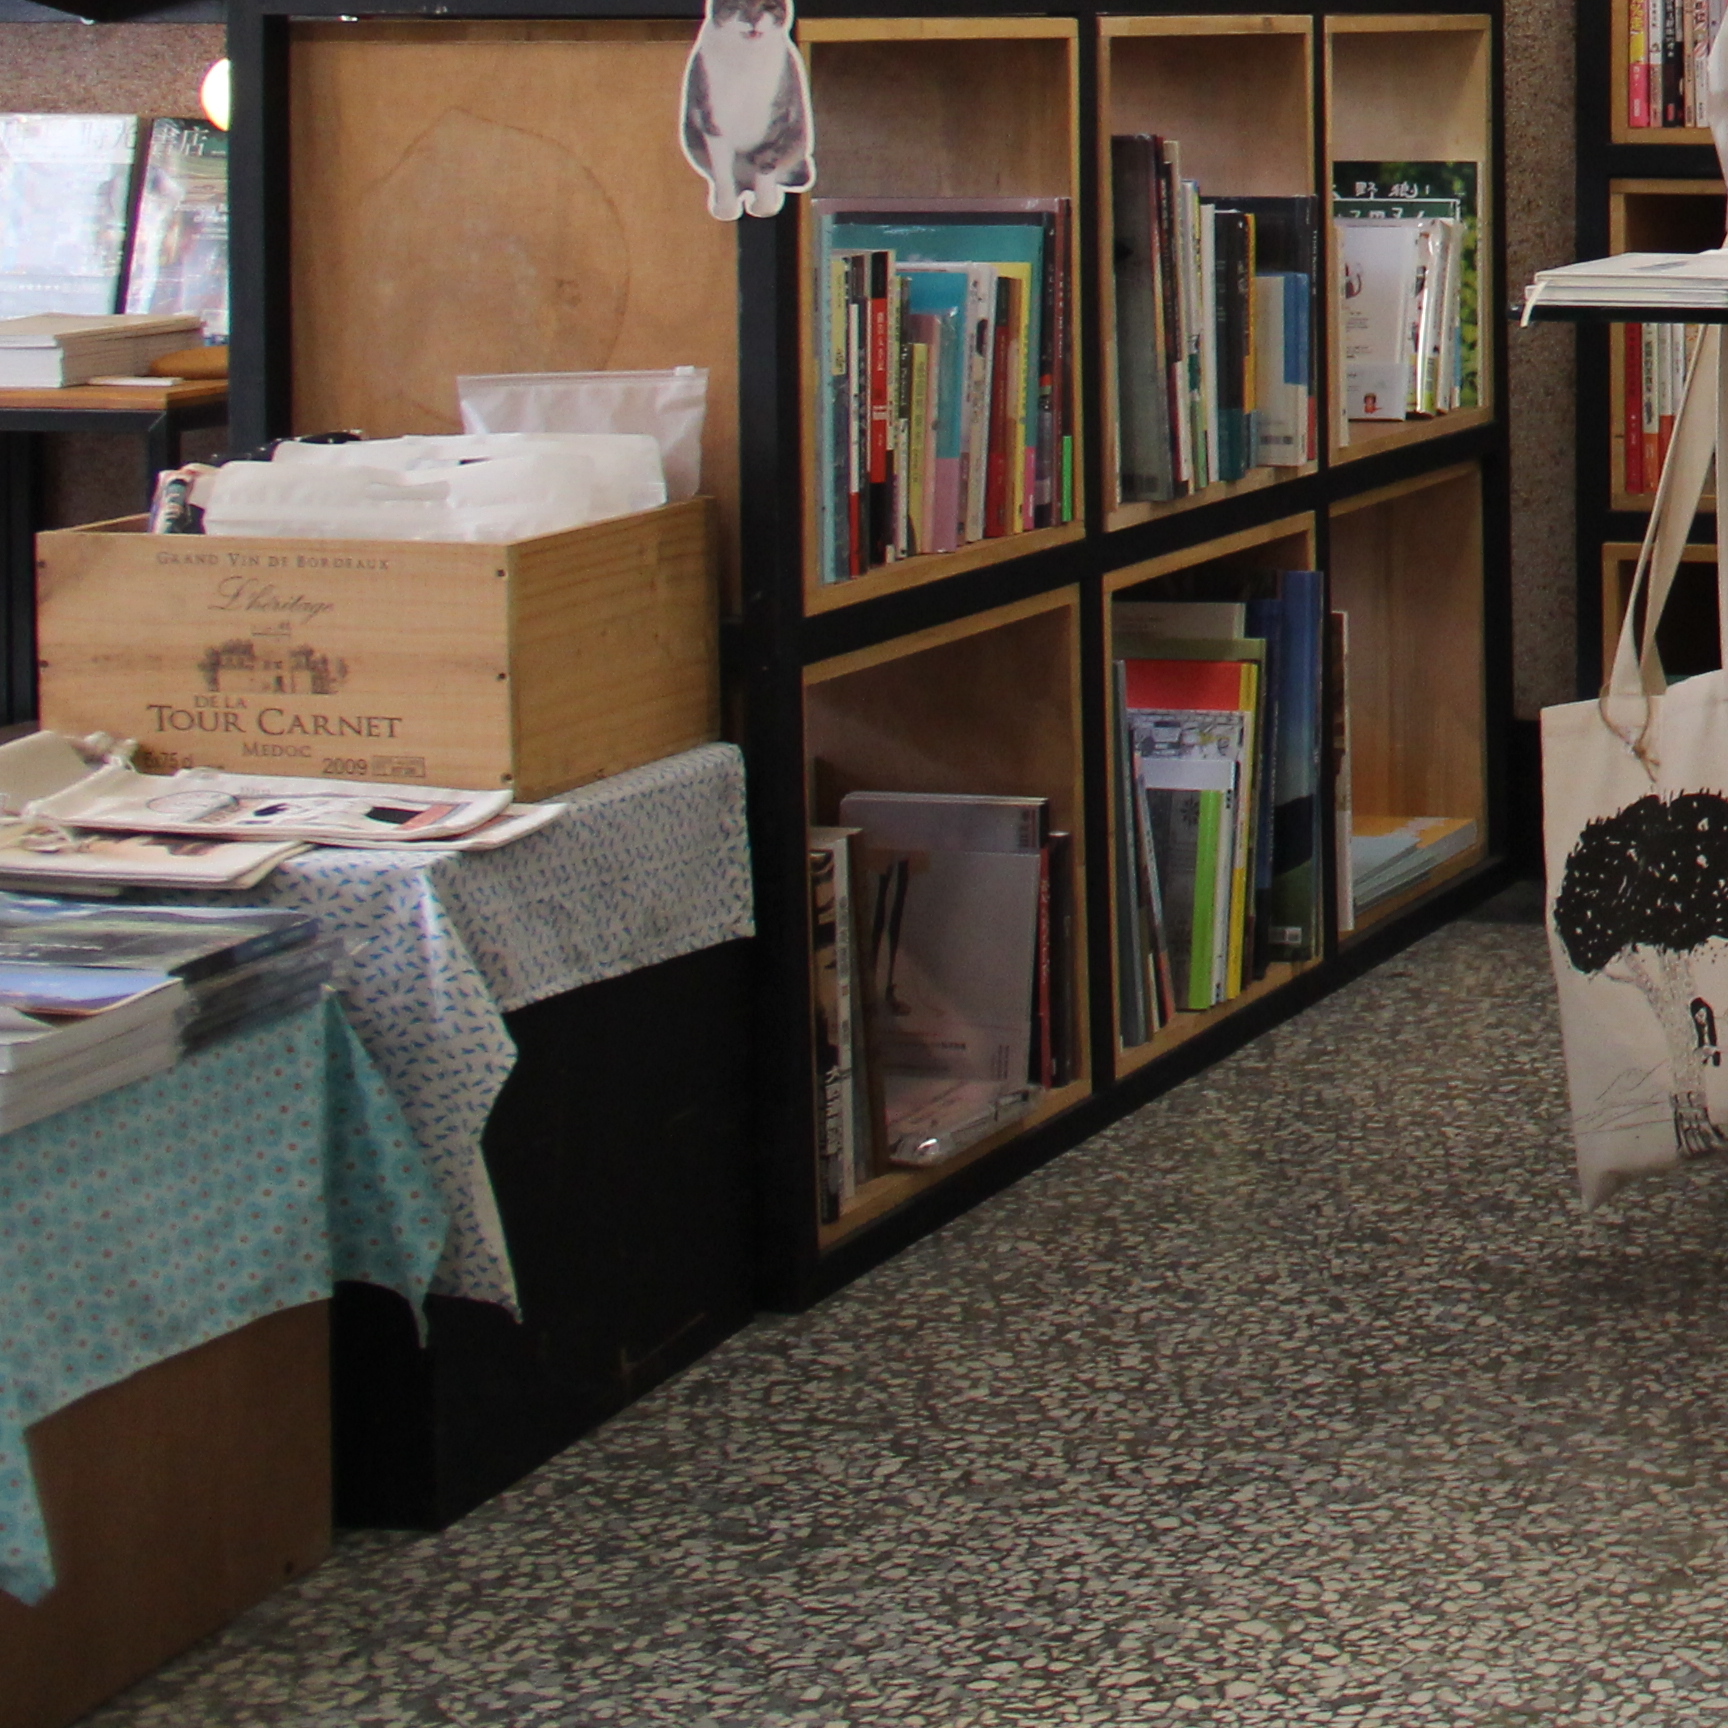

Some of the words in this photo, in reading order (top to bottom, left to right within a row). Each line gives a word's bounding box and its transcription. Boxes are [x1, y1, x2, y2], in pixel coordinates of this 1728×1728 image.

[146, 704, 247, 733] TOUR
[256, 708, 403, 739] CARNET
[242, 741, 312, 758] MEDOC
[322, 757, 367, 776] 2009
